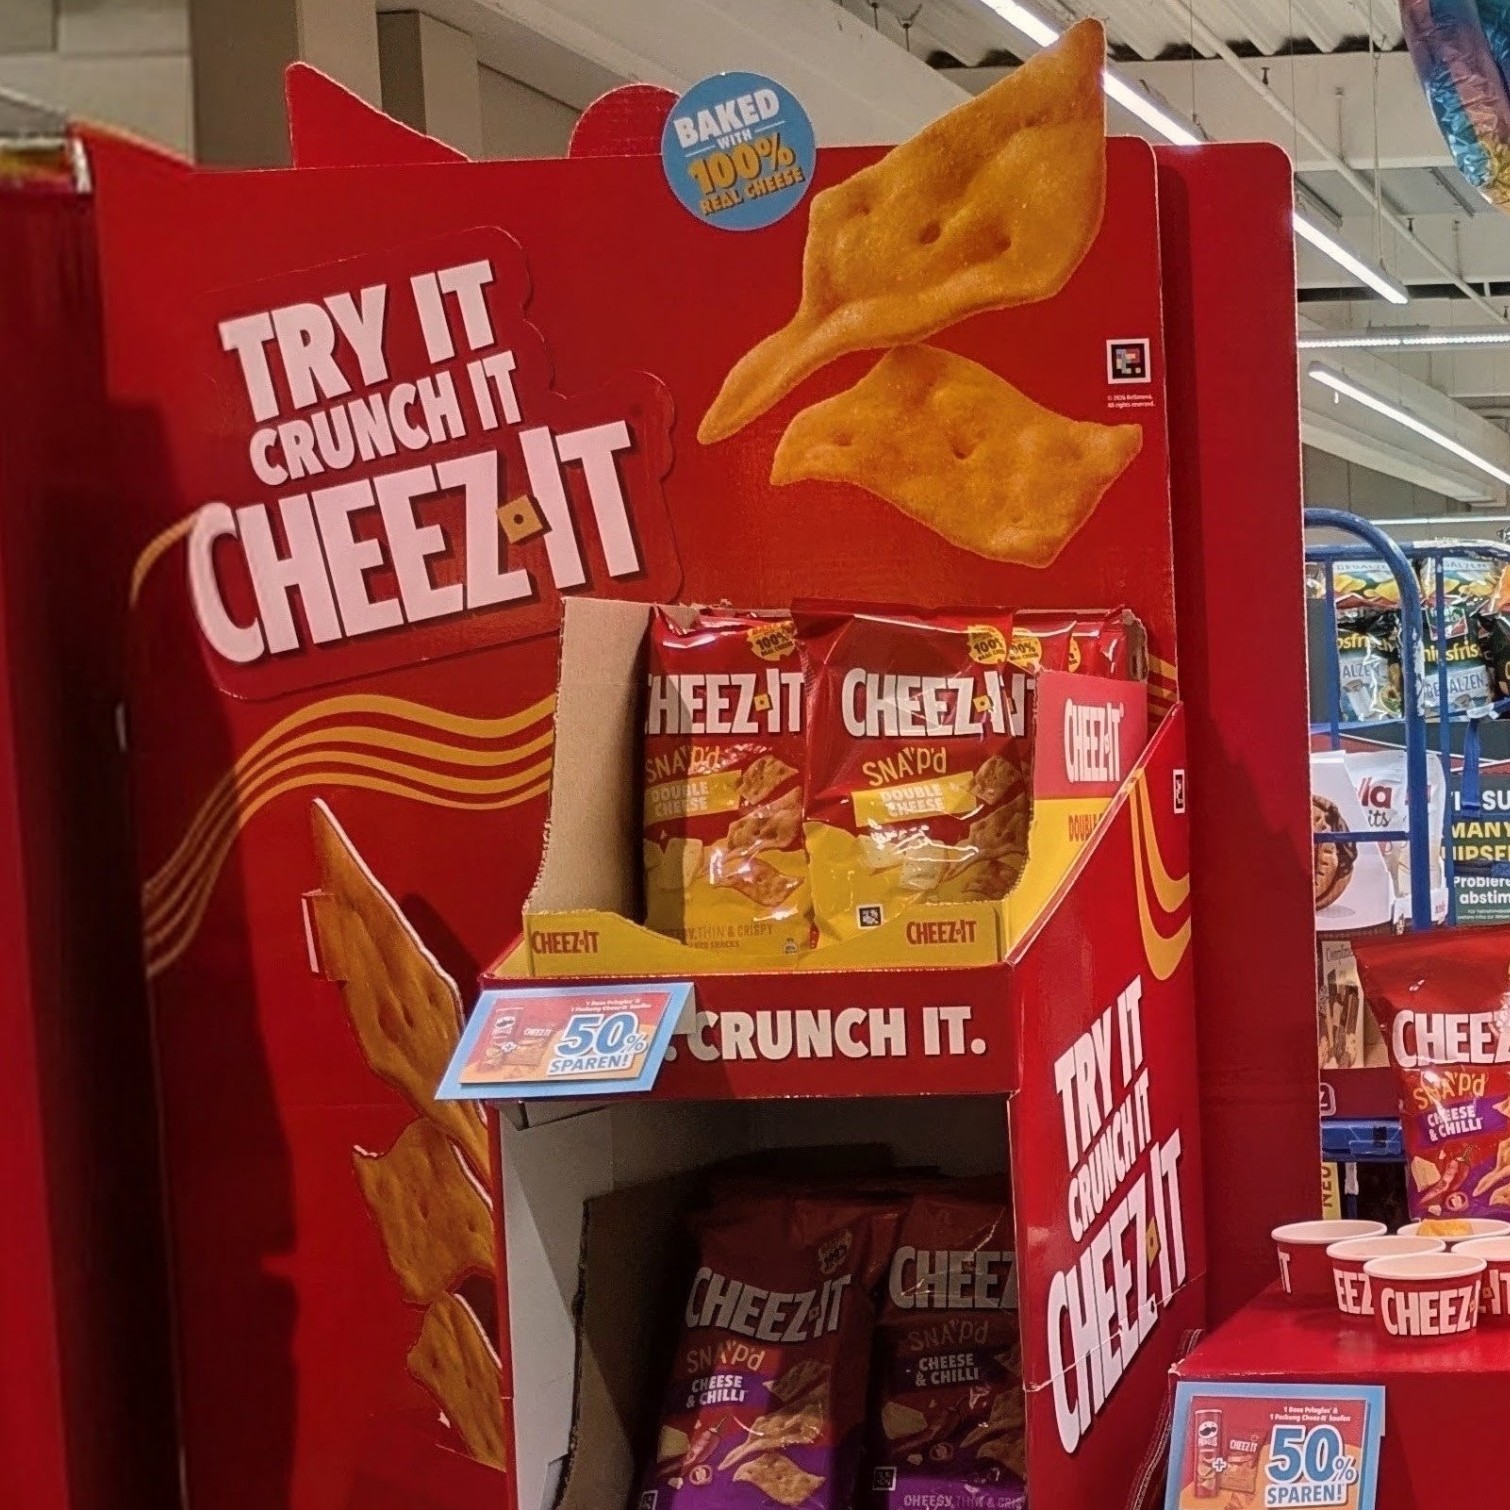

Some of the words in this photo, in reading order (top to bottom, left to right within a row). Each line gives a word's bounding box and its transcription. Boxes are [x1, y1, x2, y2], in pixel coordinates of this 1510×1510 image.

[673, 88, 780, 149] BAKED
[716, 128, 753, 150] WITH
[688, 132, 797, 196] 100%
[218, 284, 387, 423] TRY
[409, 259, 496, 364] IT
[249, 370, 467, 486] CRUNCH
[467, 350, 522, 432] IT
[557, 1013, 648, 1056] 50%
[688, 1006, 907, 1061] CRUNCH
[923, 1006, 986, 1056] IT.
[549, 1054, 630, 1074] SPAREN!
[1054, 1006, 1113, 1172] TRY
[1117, 974, 1144, 1087] IT
[1427, 1105, 1477, 1127] CHEESE
[1440, 1118, 1483, 1138] CHILLI
[1068, 1093, 1136, 1243] CRUNCH
[1133, 1068, 1152, 1156] IT
[692, 1374, 743, 1392] CHEESE
[918, 1353, 975, 1371] CHEESE
[930, 1367, 979, 1385] CHILLI
[1268, 1426, 1357, 1482] 50%
[1267, 1484, 1342, 1505] SPAREN!
